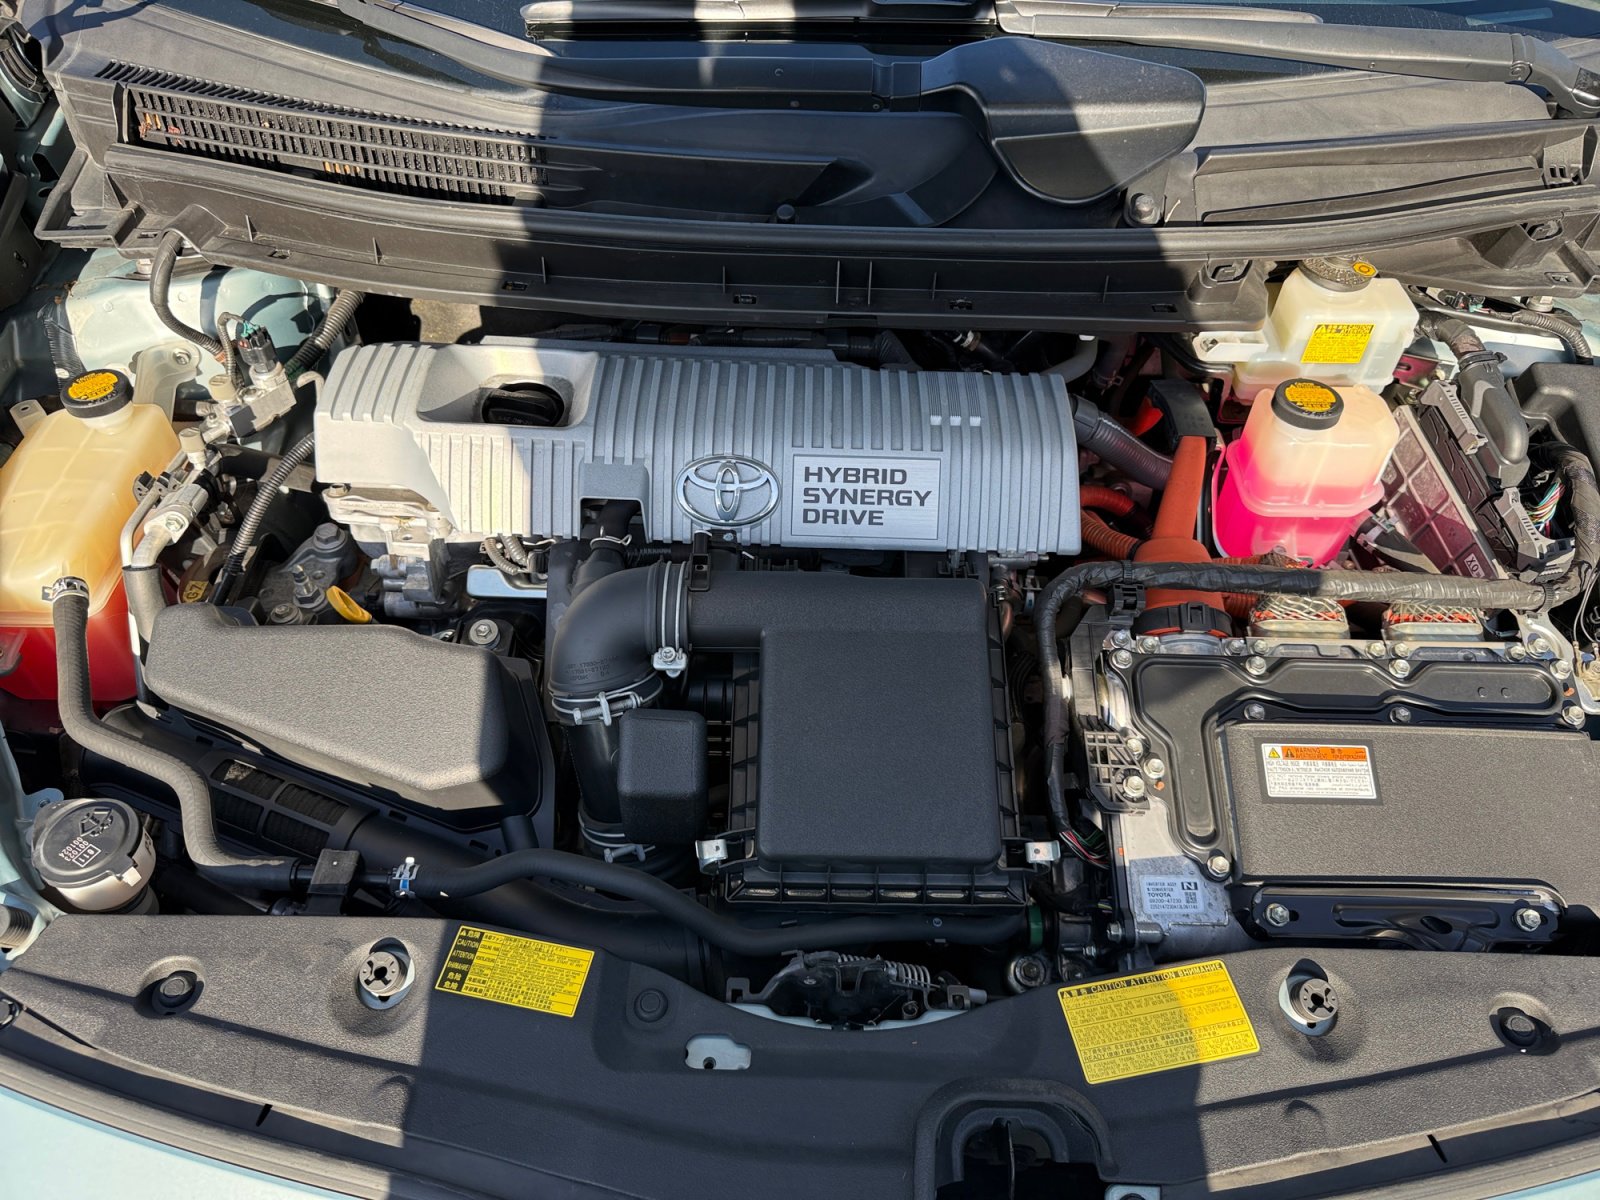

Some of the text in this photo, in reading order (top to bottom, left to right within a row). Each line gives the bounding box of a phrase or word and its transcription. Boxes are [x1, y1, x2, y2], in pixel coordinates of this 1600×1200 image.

[804, 466, 907, 485] HYBRID
[803, 487, 932, 506] SYNERGY
[803, 508, 884, 526] DRIVE
[58, 837, 83, 857] 001024
[64, 841, 88, 862] 001023
[457, 938, 479, 947] CAUTION
[452, 949, 475, 959] ATTENTION
[1090, 980, 1127, 993] CAUTION
[1130, 971, 1176, 986] ATTENTION
[1176, 962, 1222, 977] ВНИМАНИЕ
